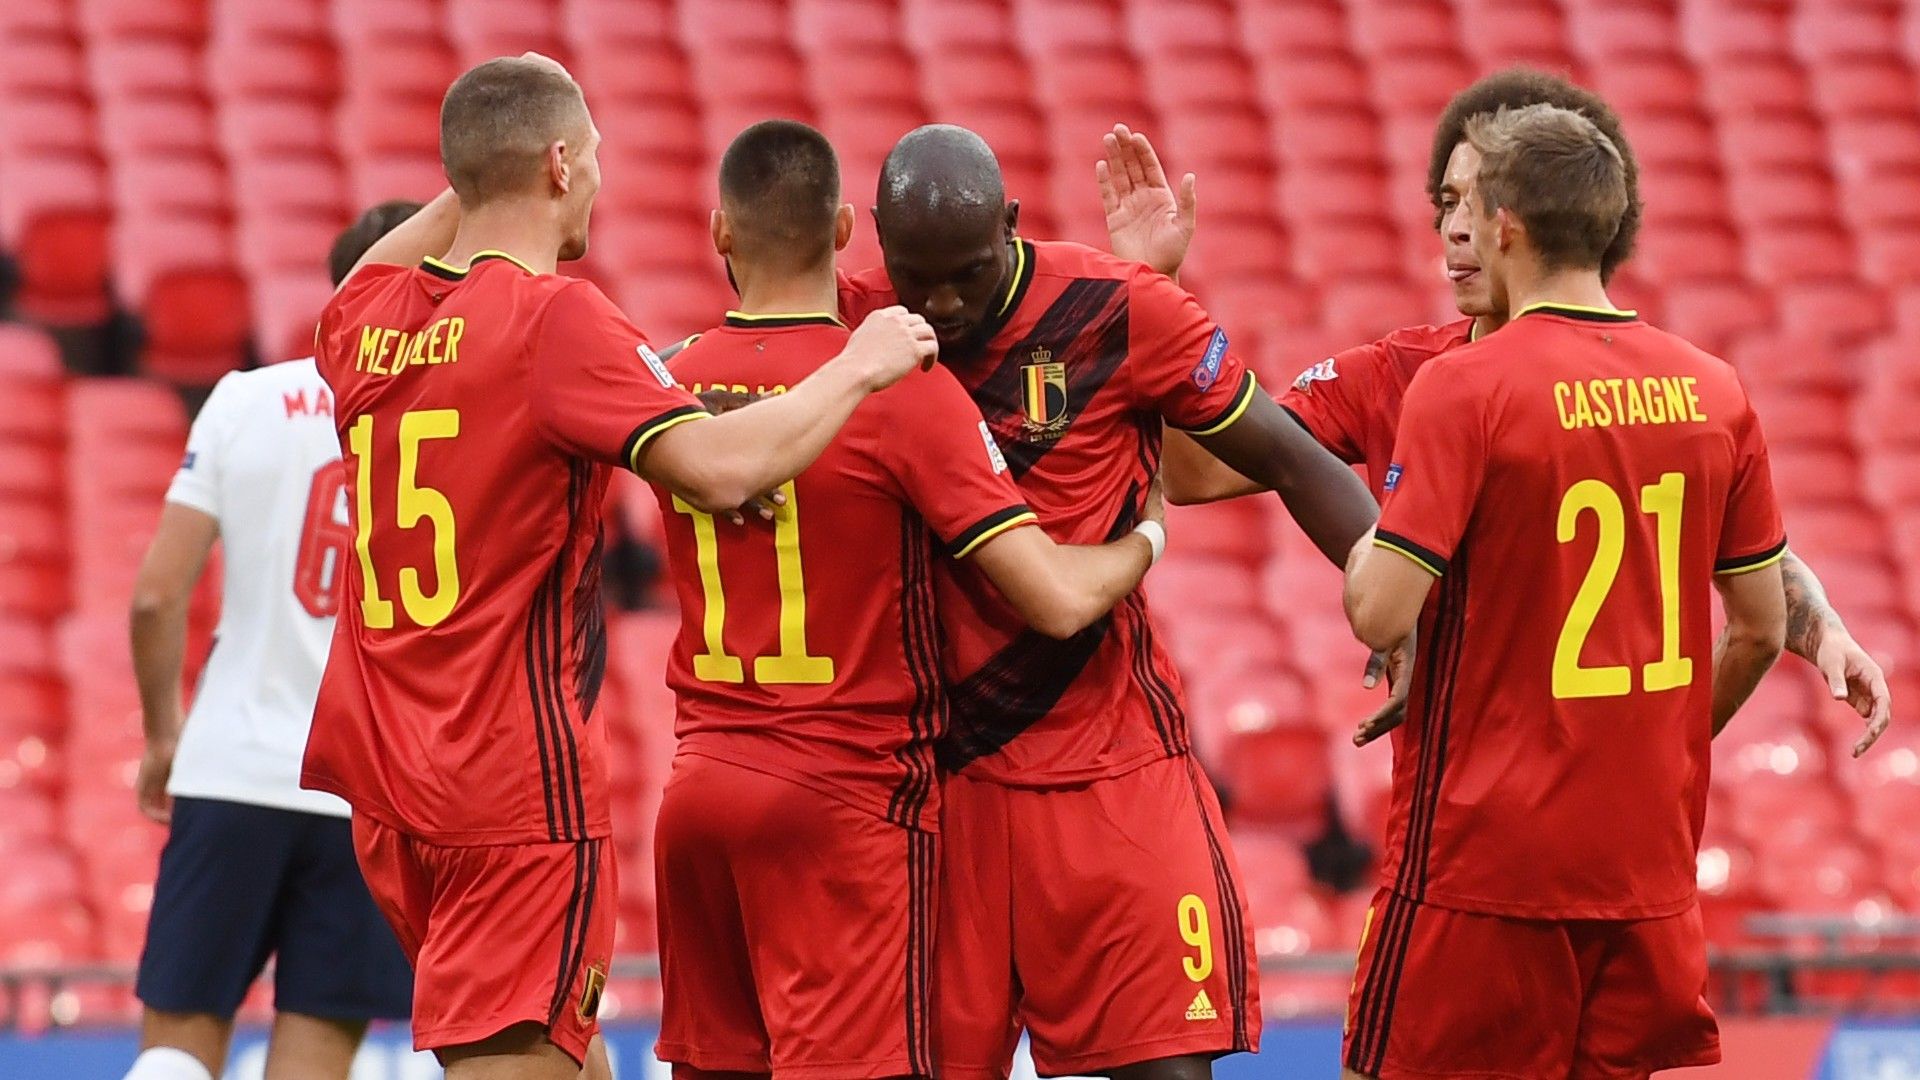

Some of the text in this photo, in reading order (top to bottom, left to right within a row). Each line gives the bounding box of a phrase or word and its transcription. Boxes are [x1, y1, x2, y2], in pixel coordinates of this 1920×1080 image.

[1554, 376, 1707, 430] CASTAGNE
[349, 409, 460, 630] 15
[671, 479, 835, 684] 11
[1552, 472, 1693, 699] 21
[1177, 894, 1213, 982] 9
[1185, 1008, 1218, 1020] adidas
